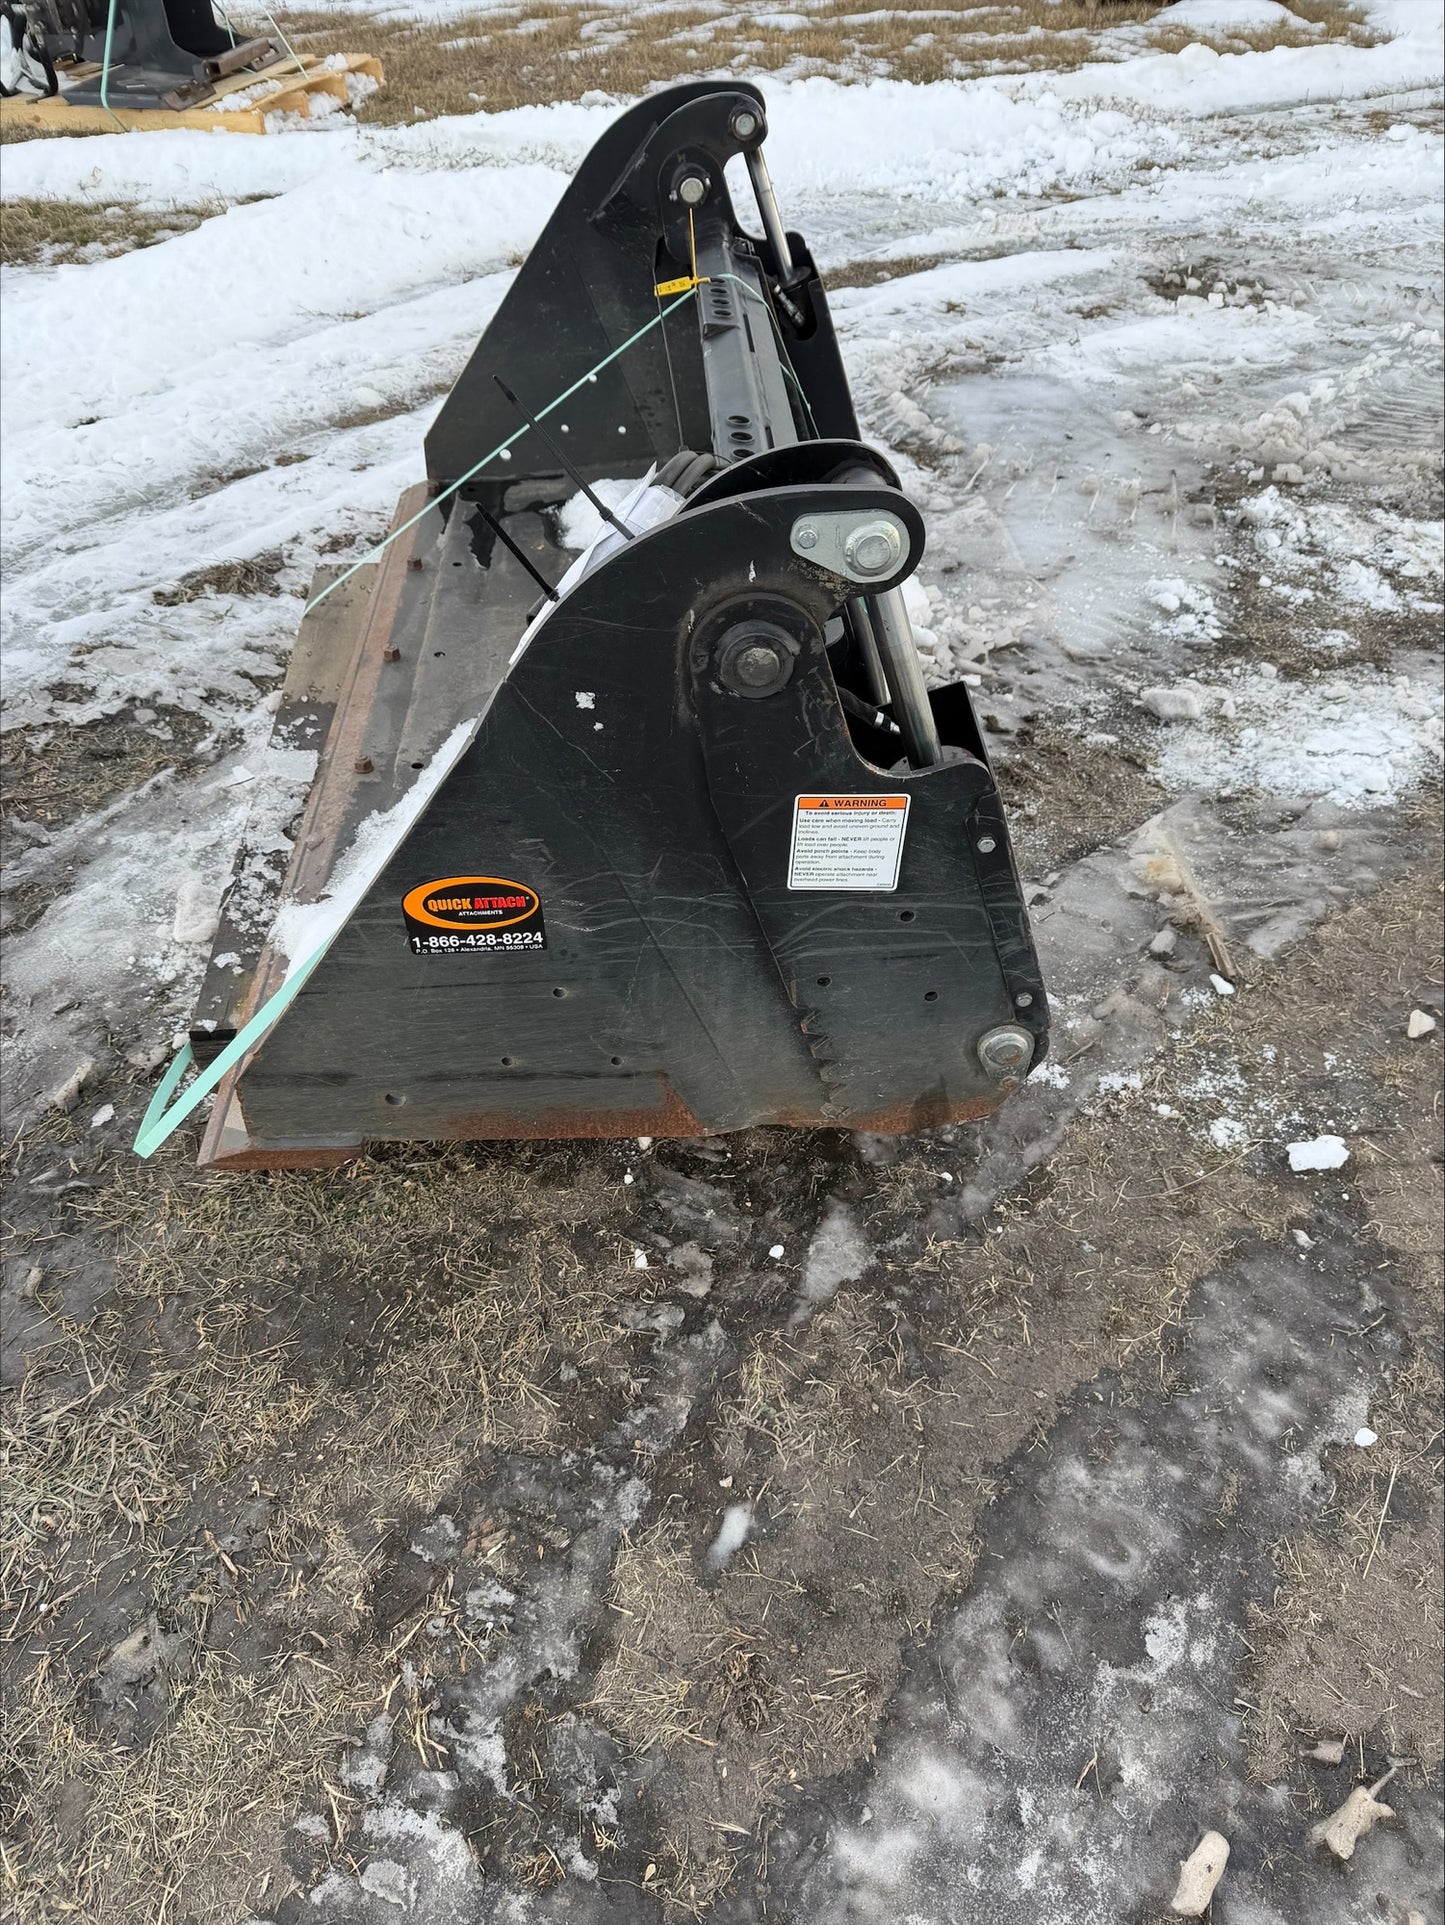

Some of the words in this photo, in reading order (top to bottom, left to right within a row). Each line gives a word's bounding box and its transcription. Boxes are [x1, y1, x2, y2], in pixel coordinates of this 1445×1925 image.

[834, 799, 887, 807] WARNING
[427, 898, 473, 912] QUICK
[474, 896, 526, 909] ATTACH
[412, 931, 543, 948] 1-866-428-8224
